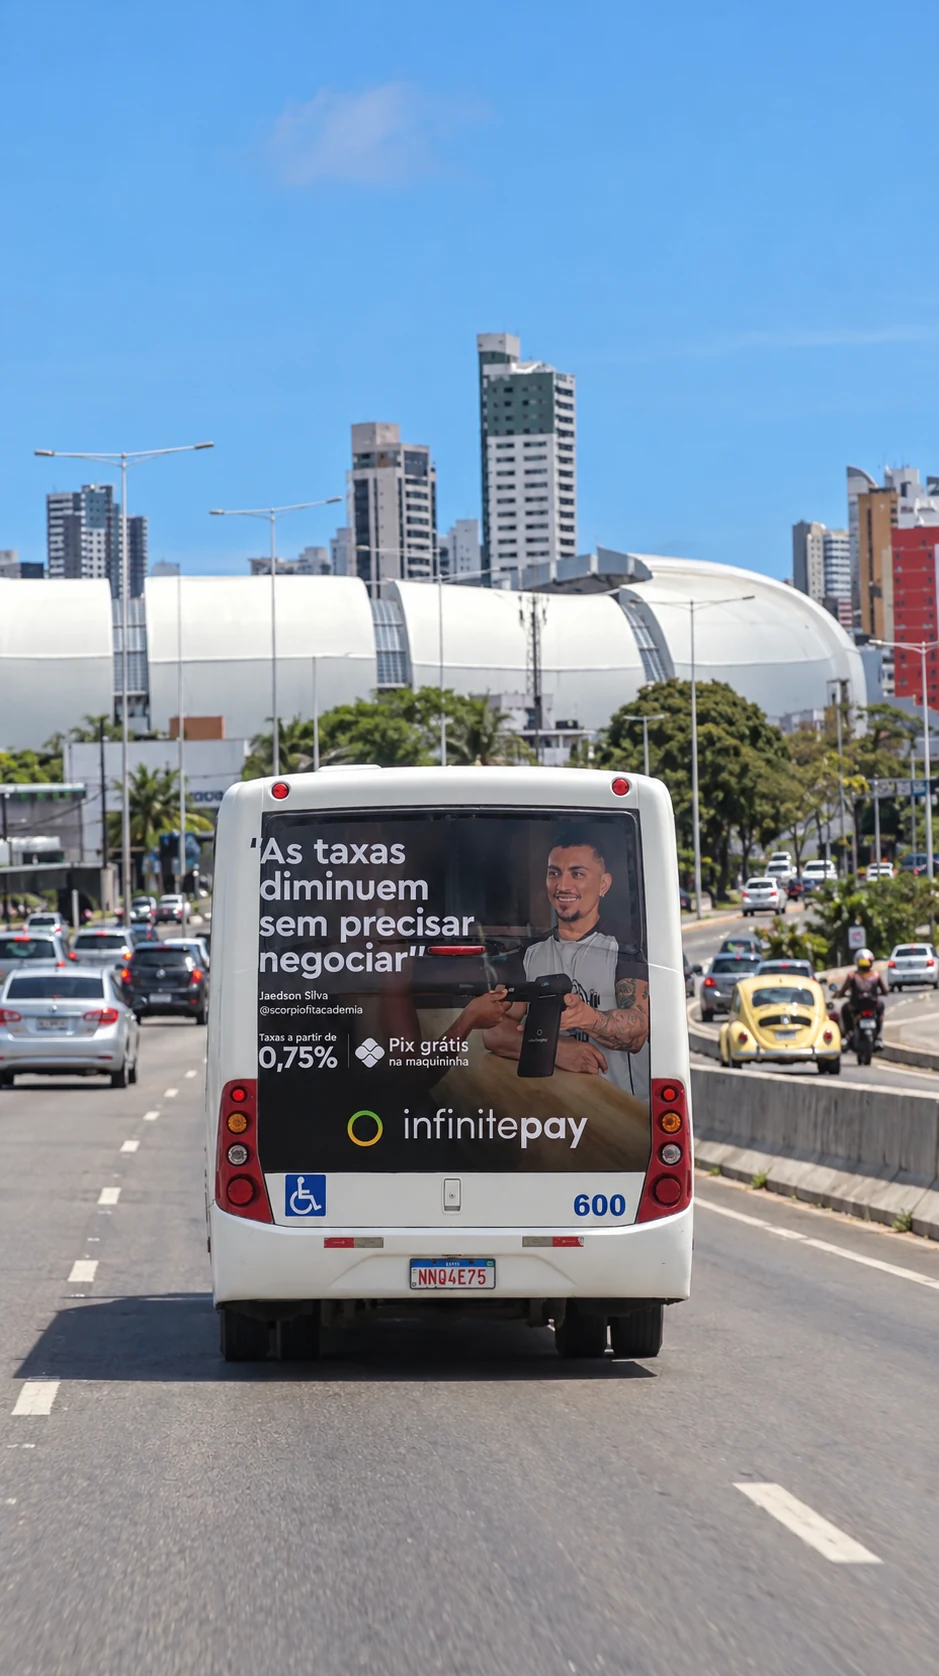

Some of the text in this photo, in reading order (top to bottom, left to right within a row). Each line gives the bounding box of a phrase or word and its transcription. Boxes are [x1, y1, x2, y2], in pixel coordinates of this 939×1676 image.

[313, 838, 406, 864] taxas
[259, 870, 429, 901] diminuem
[259, 906, 475, 943] sem precisar
[258, 990, 329, 1001] Jaedson Silva
[259, 1004, 363, 1017] @scorpiofitacademia
[258, 1033, 285, 1043] Taxas
[296, 1033, 322, 1045] partir
[324, 1033, 337, 1042] de
[389, 1035, 469, 1056] Pix grátis
[258, 1045, 339, 1073] 0,75%
[389, 1056, 469, 1070] na maquininha
[403, 1108, 588, 1149] infinitepay
[573, 1194, 626, 1217] 600
[418, 1268, 487, 1286] NNQ4E75
